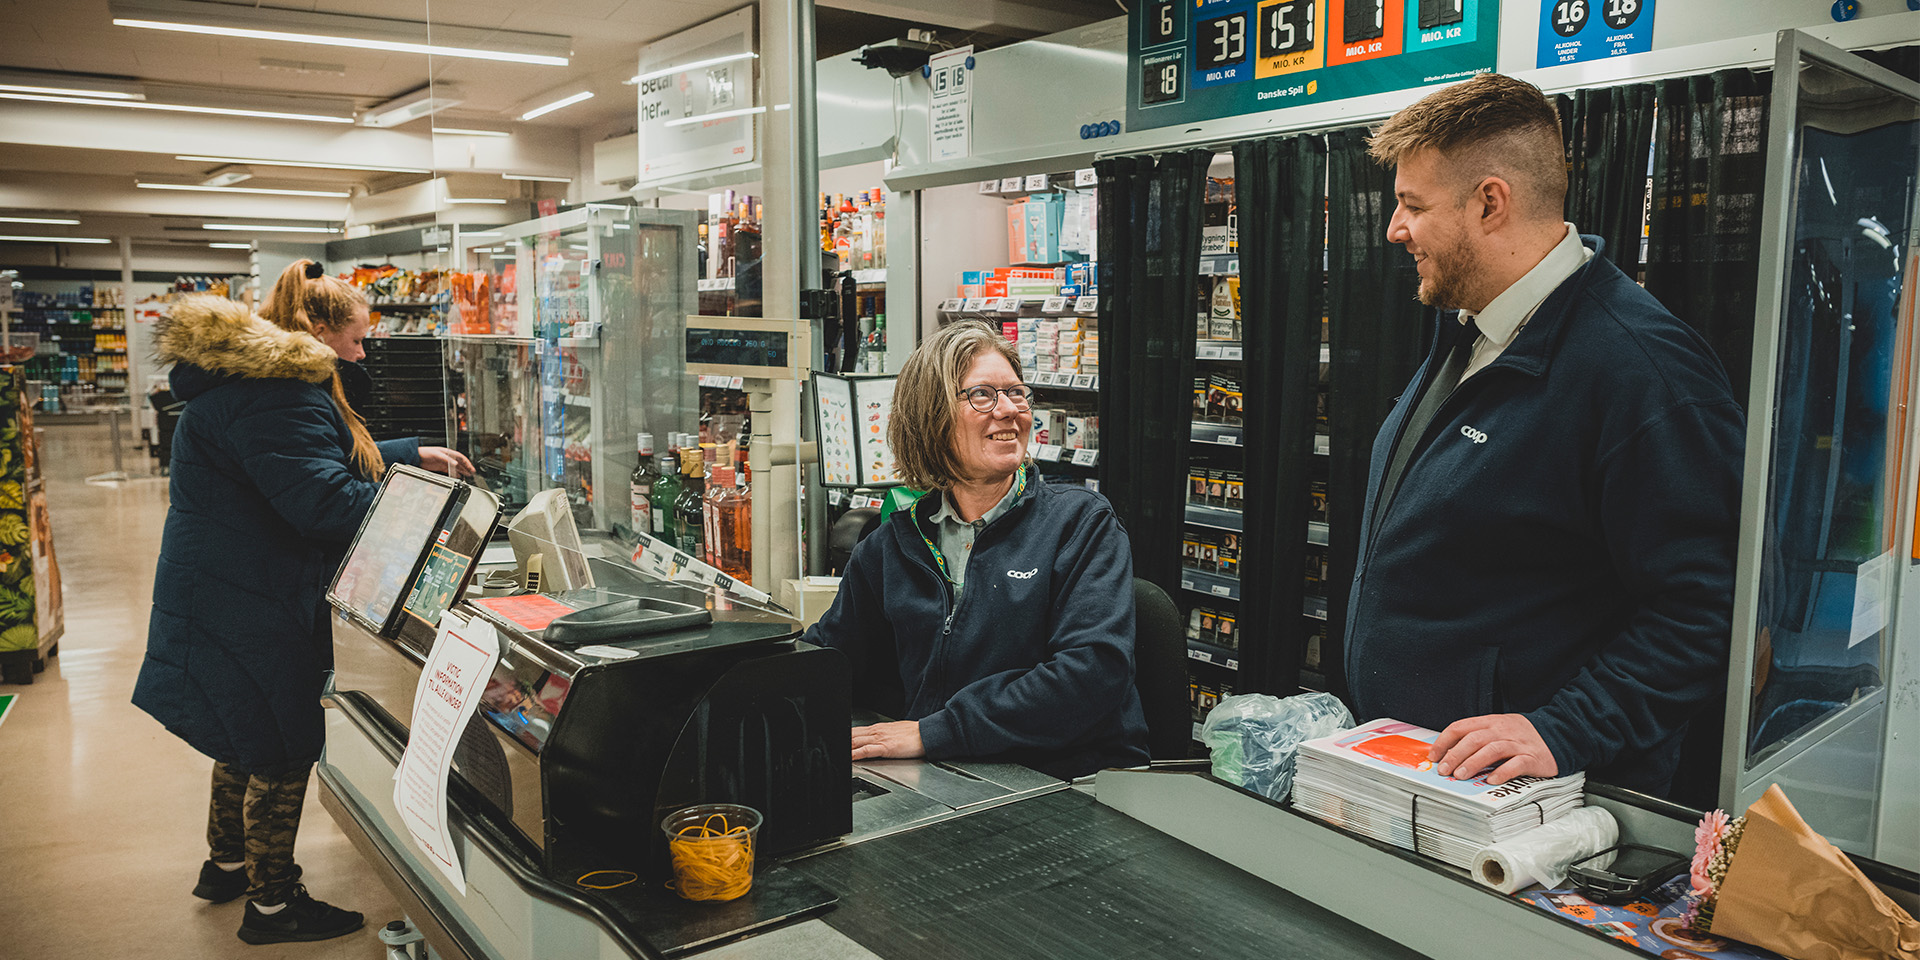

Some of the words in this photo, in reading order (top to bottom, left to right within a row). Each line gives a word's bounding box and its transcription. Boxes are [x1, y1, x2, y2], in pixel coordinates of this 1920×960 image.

[1557, 1, 1584, 25] 16
[1609, 0, 1637, 17] 18
[1161, 5, 1172, 35] 6
[1271, 2, 1313, 49] 151
[1617, 17, 1627, 25] ÅR
[1213, 16, 1245, 62] 33
[1421, 32, 1444, 43] MIO.
[1446, 27, 1461, 39] KR
[1555, 40, 1582, 49] ALKOHOL
[1606, 33, 1635, 43] ALKOHOL
[1345, 47, 1366, 57] MIO.
[1368, 42, 1382, 53] KR
[1272, 60, 1291, 70] MIO.
[1293, 57, 1305, 66] KR
[935, 71, 947, 92] 15
[952, 66, 965, 87] 18
[1161, 64, 1177, 94] 18
[1206, 71, 1223, 82] MIO.
[1224, 69, 1236, 79] KR
[1257, 87, 1287, 100] Danske
[1288, 85, 1303, 97] Spil
[641, 100, 670, 122] her...
[1460, 425, 1488, 444] coop
[1006, 567, 1038, 579] coop
[435, 669, 465, 696] INFORMATION
[434, 684, 446, 698] ALLE
[444, 692, 462, 711] KUNDER
